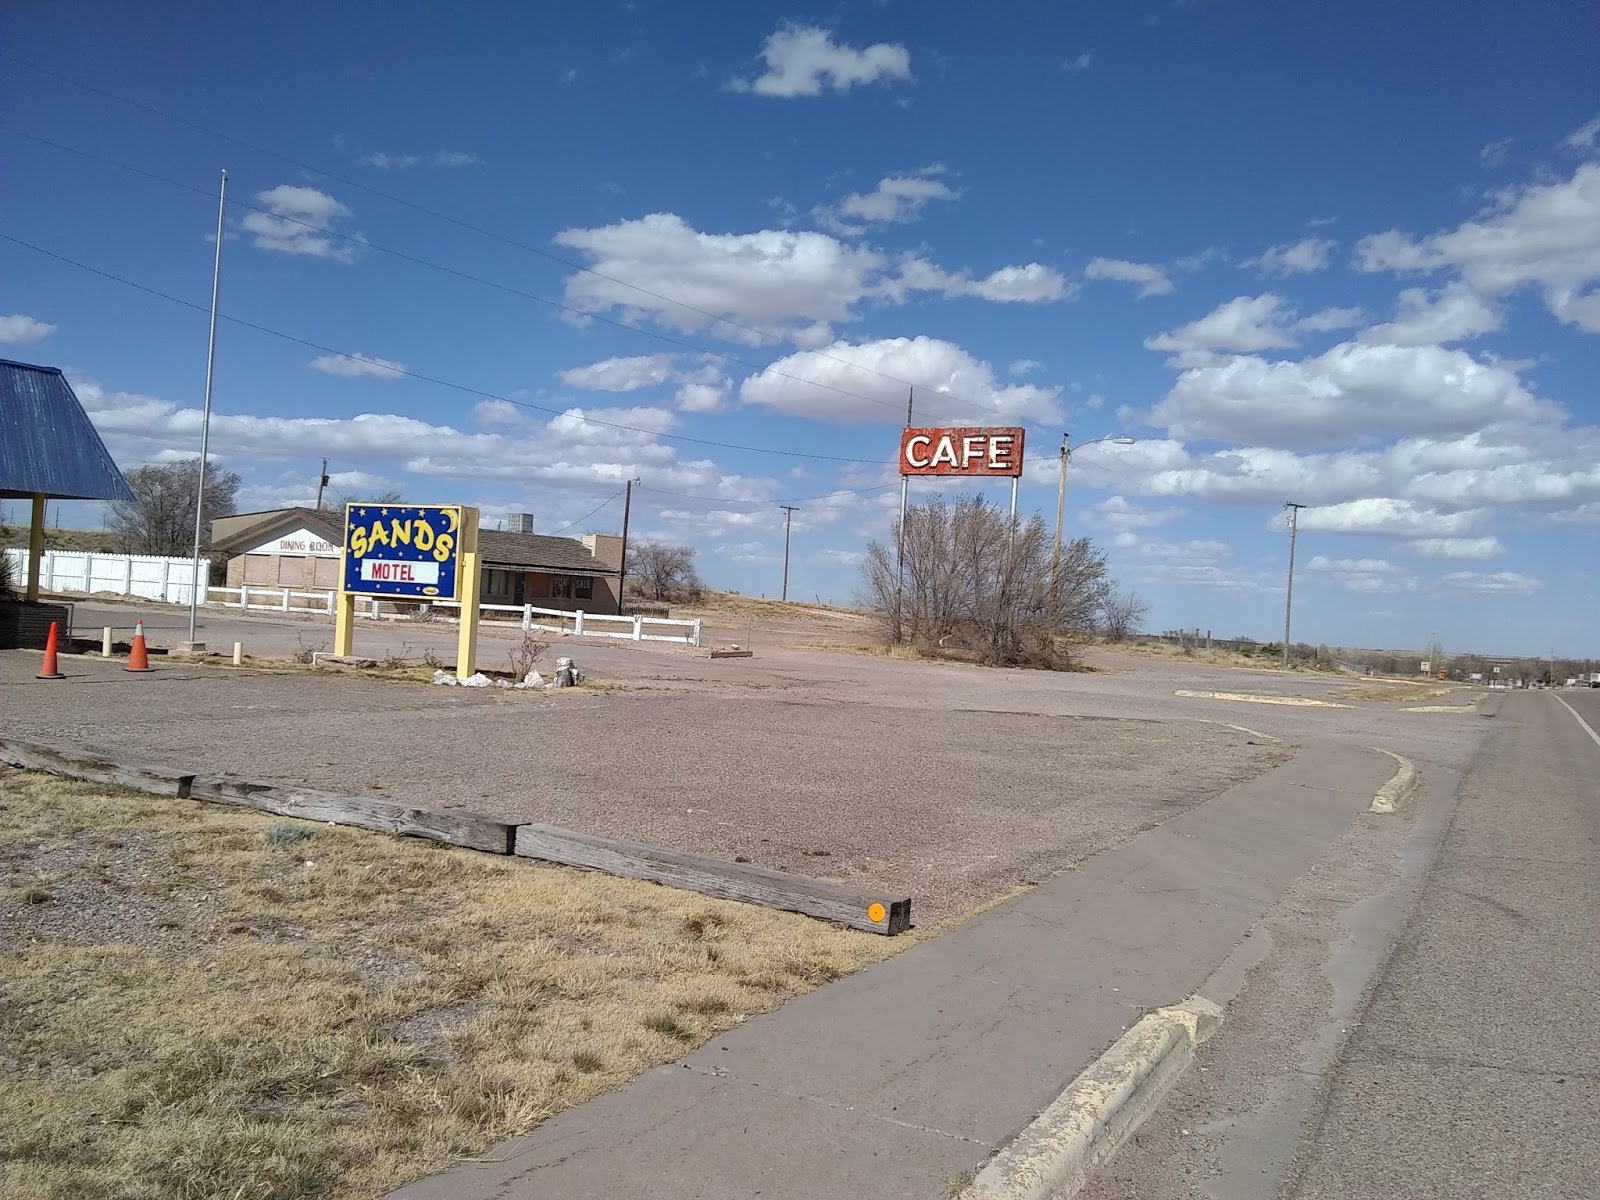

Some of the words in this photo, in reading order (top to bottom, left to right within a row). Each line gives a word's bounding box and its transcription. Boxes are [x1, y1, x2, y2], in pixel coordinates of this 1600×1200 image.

[905, 434, 1015, 469] CAFE
[280, 540, 306, 551] DINING
[309, 541, 334, 552] ROOM
[350, 518, 454, 562] SANDS
[371, 563, 415, 581] MOTEL
[554, 578, 568, 588] FOR
[575, 579, 591, 589] SALE
